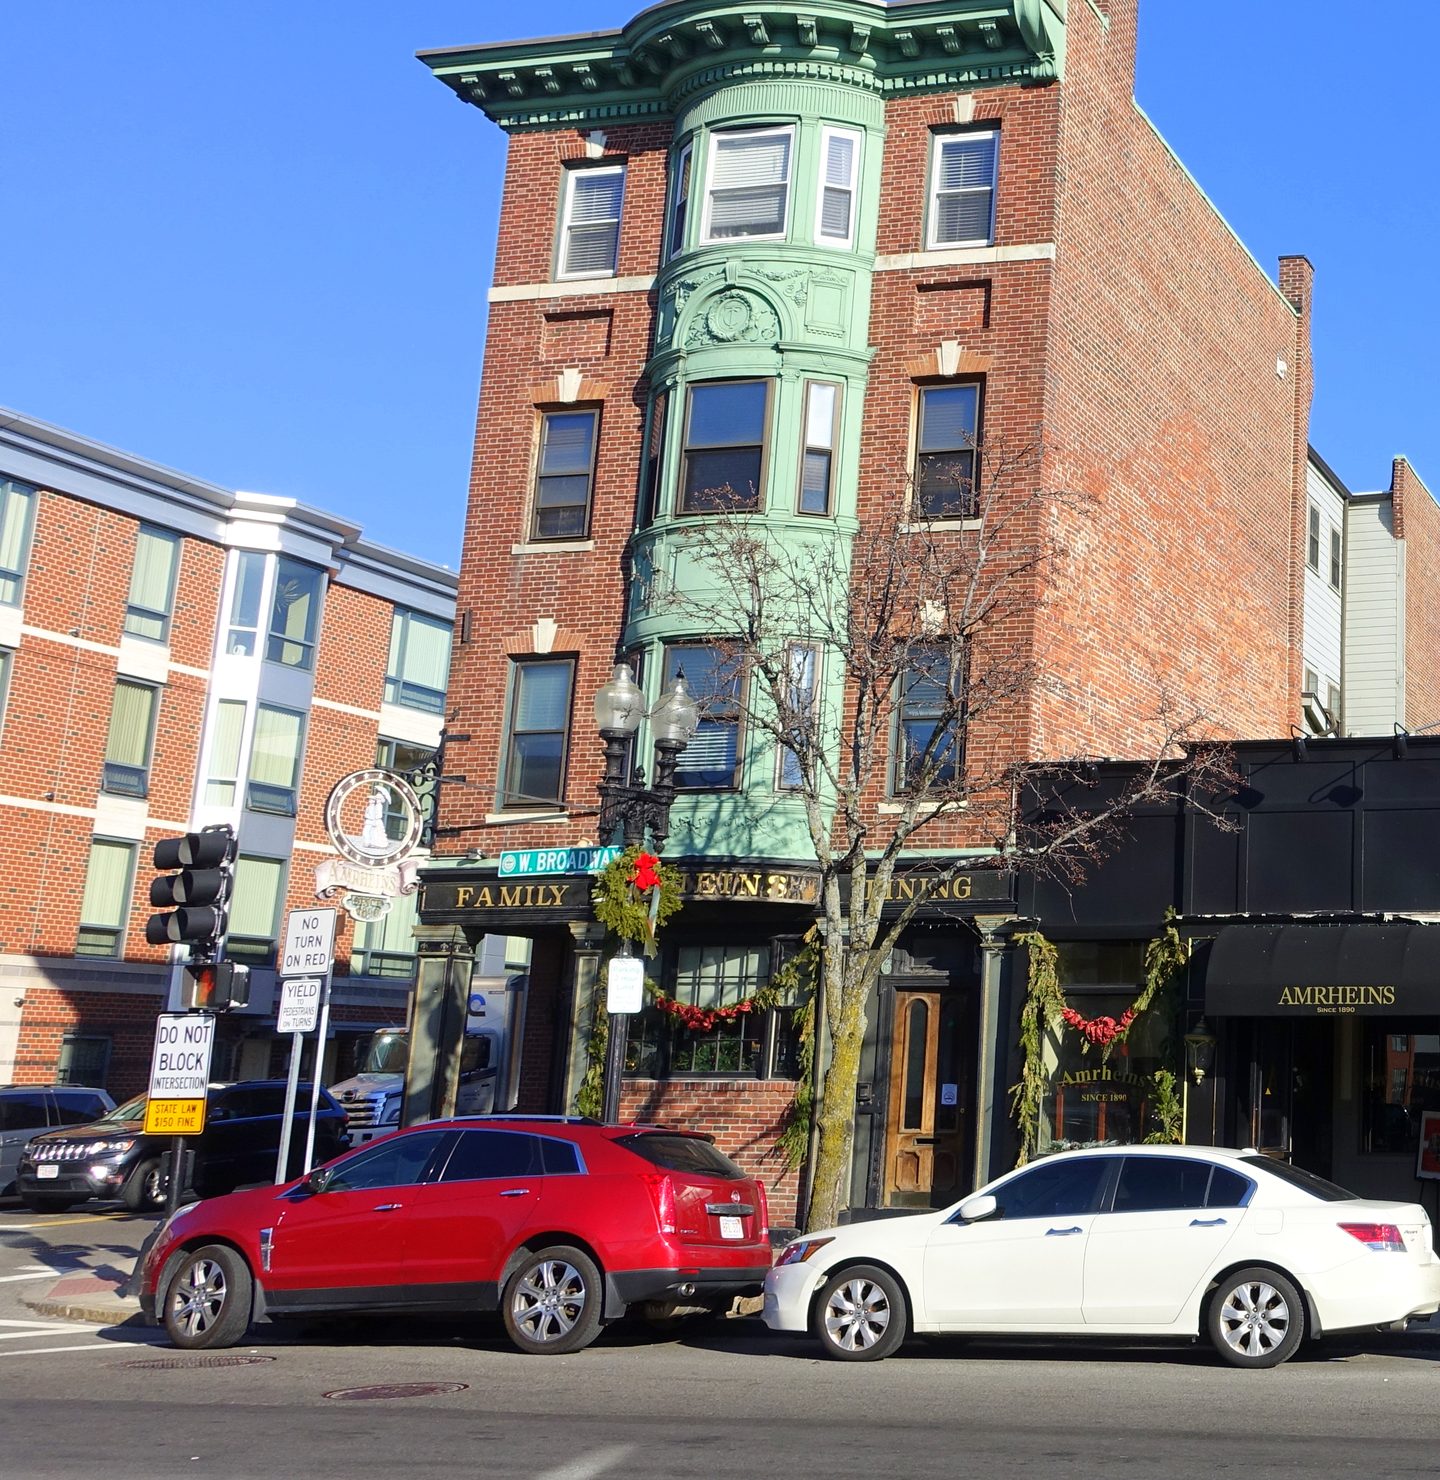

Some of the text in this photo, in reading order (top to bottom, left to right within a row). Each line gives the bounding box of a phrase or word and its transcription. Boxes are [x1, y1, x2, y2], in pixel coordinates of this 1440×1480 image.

[519, 855, 533, 872] W.
[678, 871, 788, 897] EINS
[456, 885, 570, 908] FAMILY
[302, 917, 319, 930] NO
[295, 935, 322, 949] TURN
[286, 953, 326, 967] ON RED
[287, 984, 317, 998] YIELD
[1277, 985, 1396, 1005] AMRHEINS
[283, 1006, 315, 1017] PEDESTRIANS
[292, 1017, 312, 1027] TURNS
[159, 1025, 211, 1044] DO NOT
[159, 1052, 204, 1071] BLOCK
[153, 1076, 206, 1090] INTERSECTION
[1062, 1065, 1146, 1088] Amrheins
[1081, 1093, 1127, 1102] SINCE 1890
[155, 1104, 197, 1114] STATE LAW
[154, 1117, 195, 1128] $150 FINE
